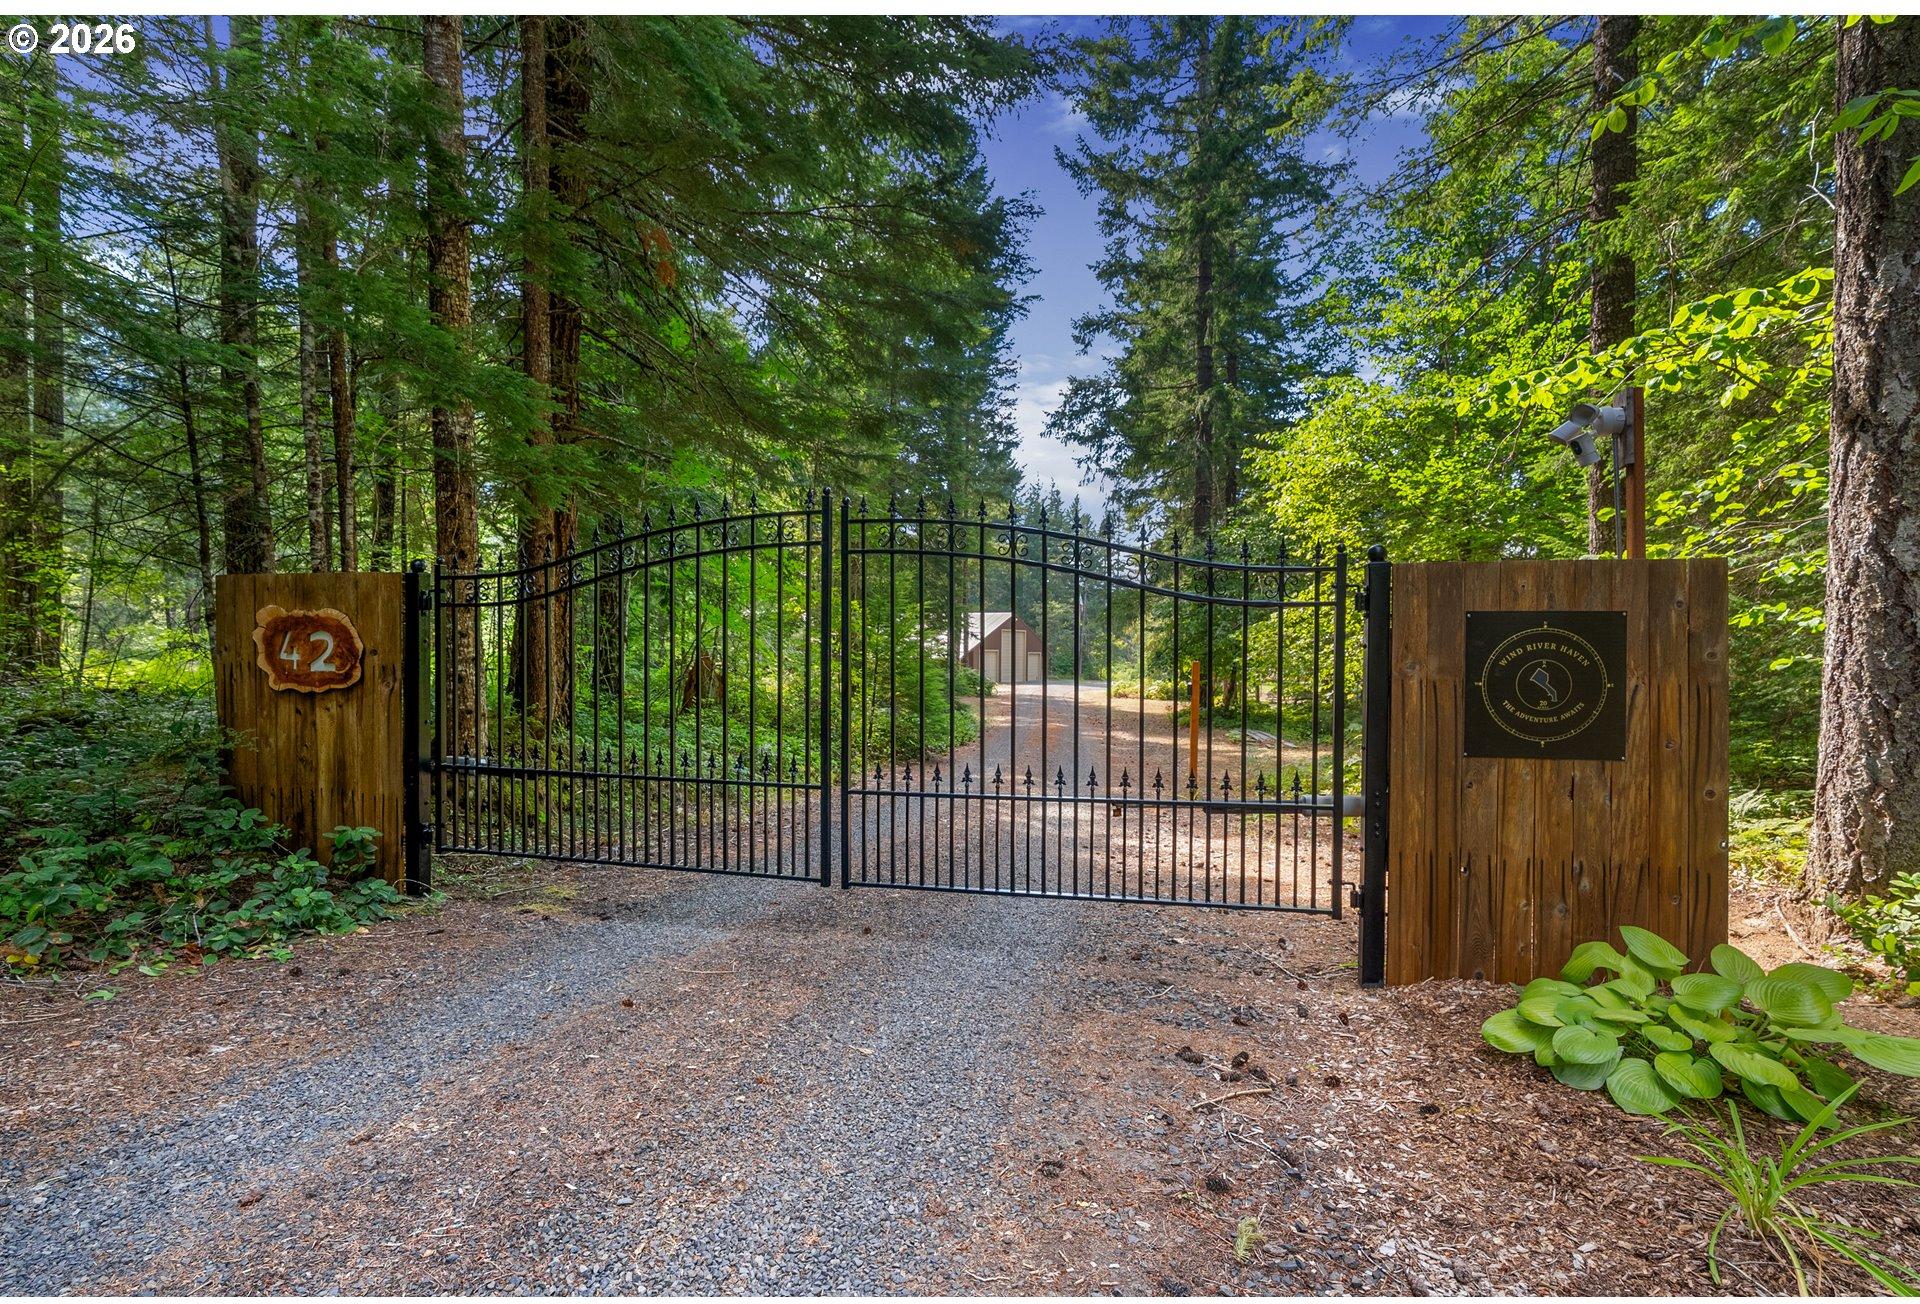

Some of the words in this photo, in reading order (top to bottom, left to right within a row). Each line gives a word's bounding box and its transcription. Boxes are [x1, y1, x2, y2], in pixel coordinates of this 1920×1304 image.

[279, 630, 336, 672] 42
[1498, 647, 1523, 667] WIND
[1526, 642, 1556, 652] RIVER
[1560, 645, 1590, 667] HAVEN
[1502, 699, 1516, 713] THE
[1515, 711, 1559, 724] ADVENTURE
[1560, 702, 1585, 721] AWAITS
